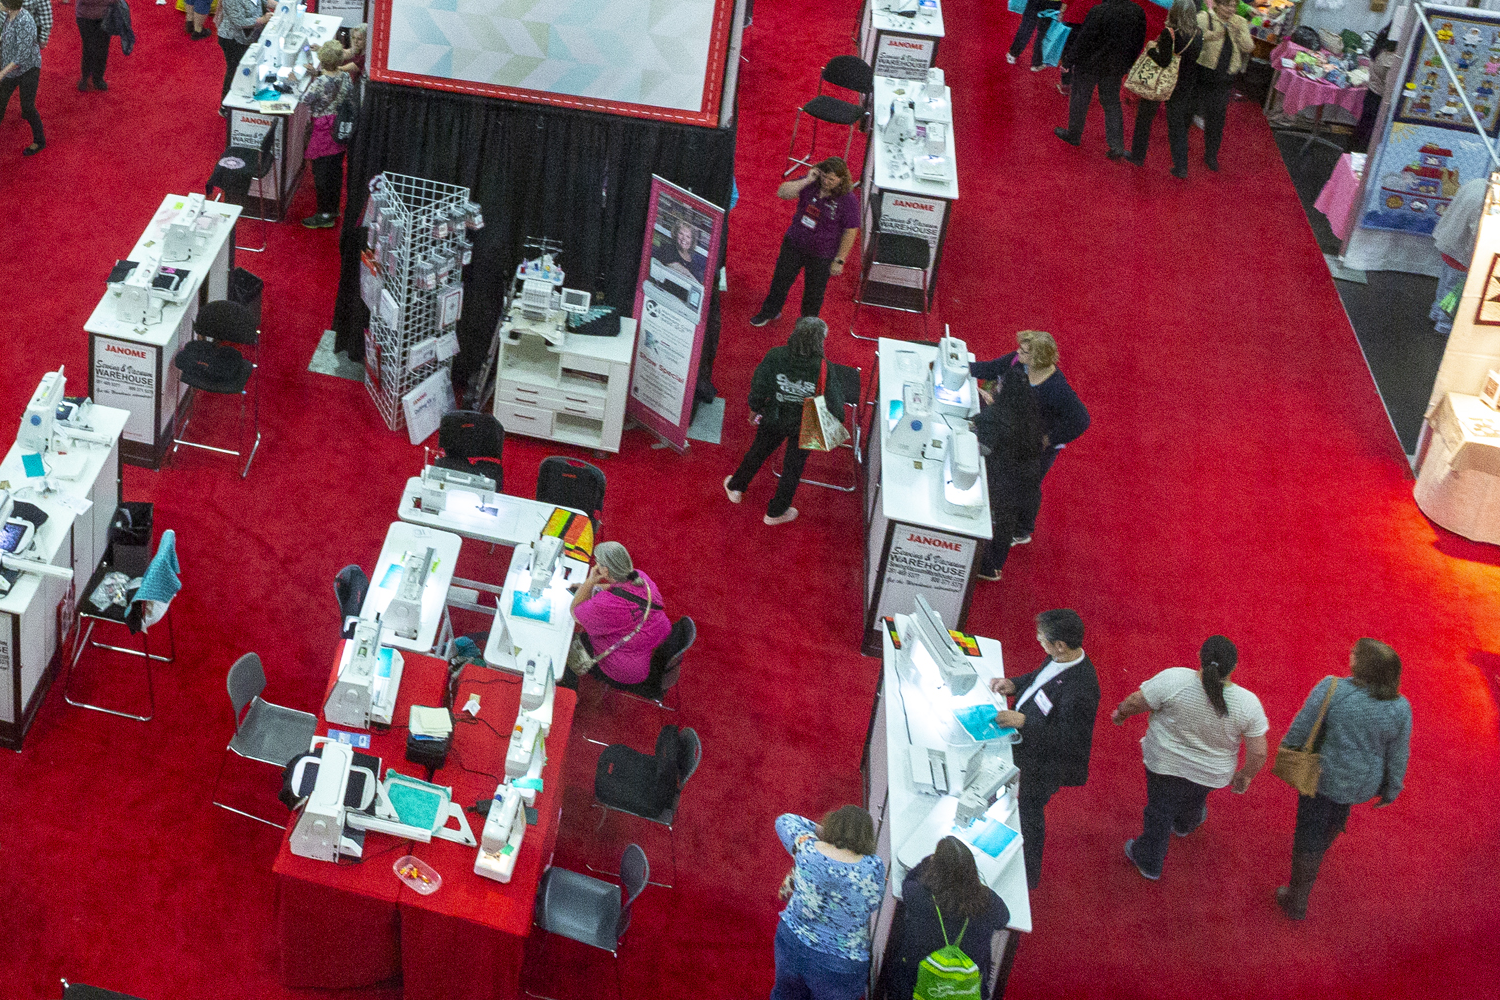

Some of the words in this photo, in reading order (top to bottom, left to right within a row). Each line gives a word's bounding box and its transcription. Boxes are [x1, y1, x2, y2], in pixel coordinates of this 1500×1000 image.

[887, 40, 924, 51] JANOME
[893, 199, 935, 212] JANOME
[880, 221, 938, 236] WAREHOUSE
[105, 344, 147, 359] JANOME
[95, 368, 154, 386] WAREHOUSE
[906, 533, 962, 552] JANOME
[889, 553, 967, 578] WAREHOUSE
